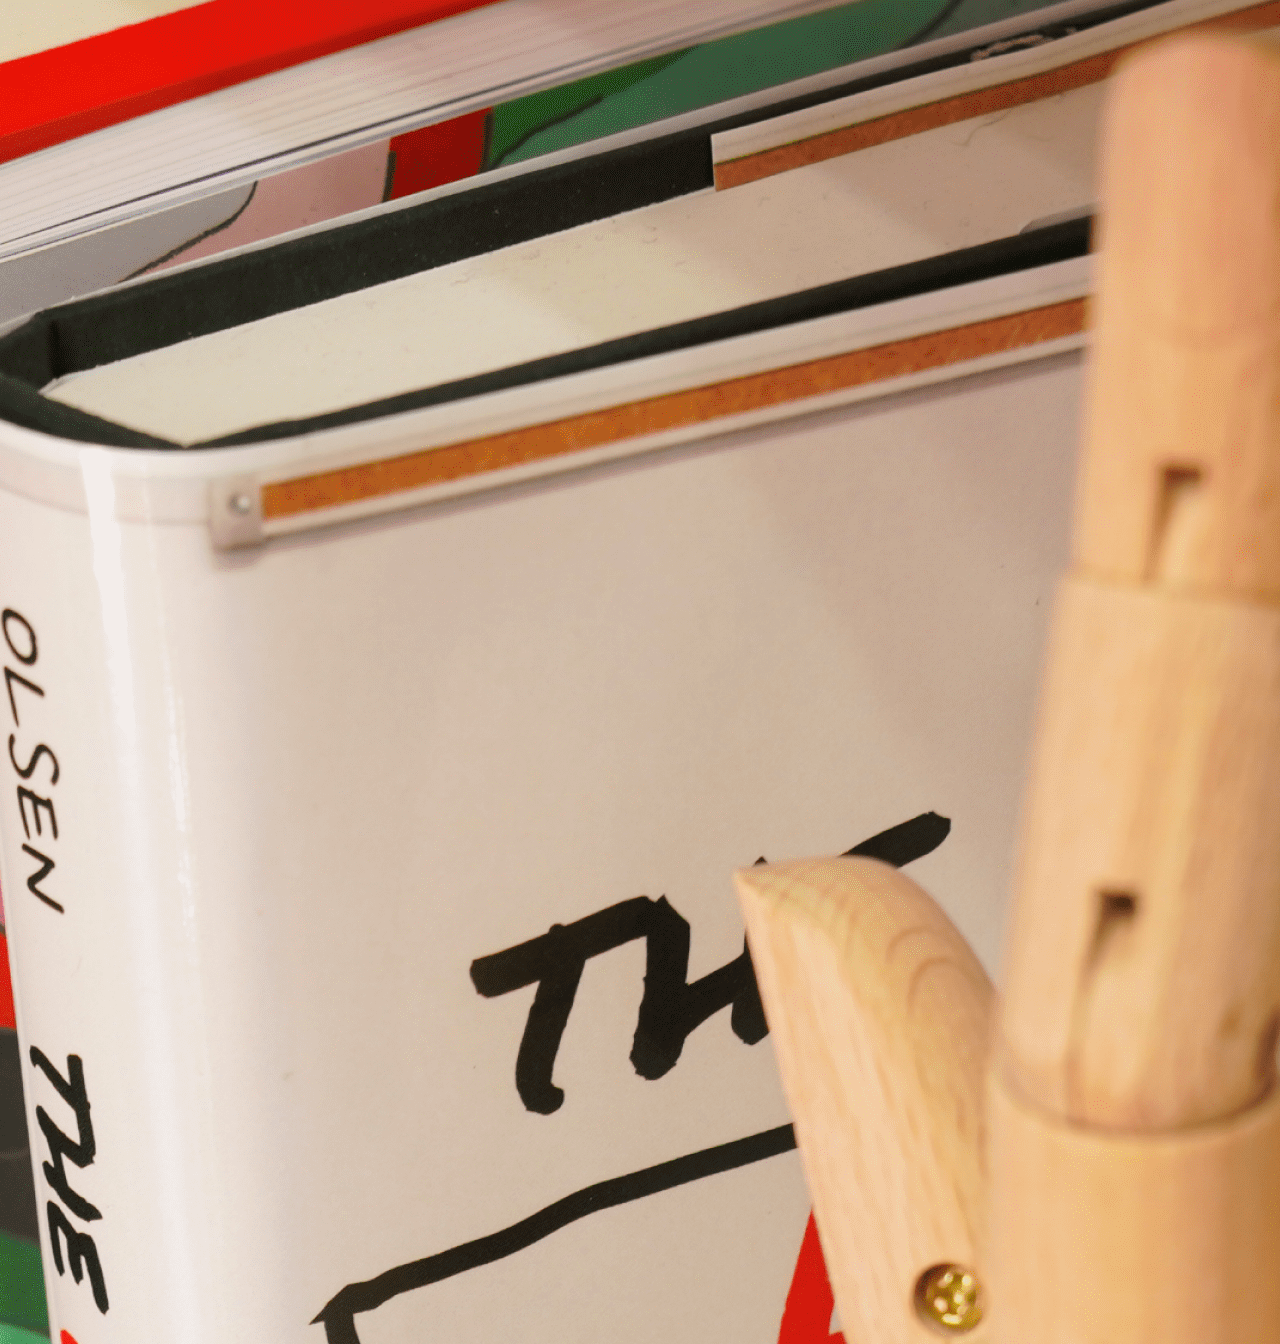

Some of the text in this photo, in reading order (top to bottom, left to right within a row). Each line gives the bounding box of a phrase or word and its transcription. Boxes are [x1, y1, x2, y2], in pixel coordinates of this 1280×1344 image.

[0, 605, 66, 916] OLSEN
[469, 810, 952, 1115] TH
[29, 1043, 110, 1316] THE
